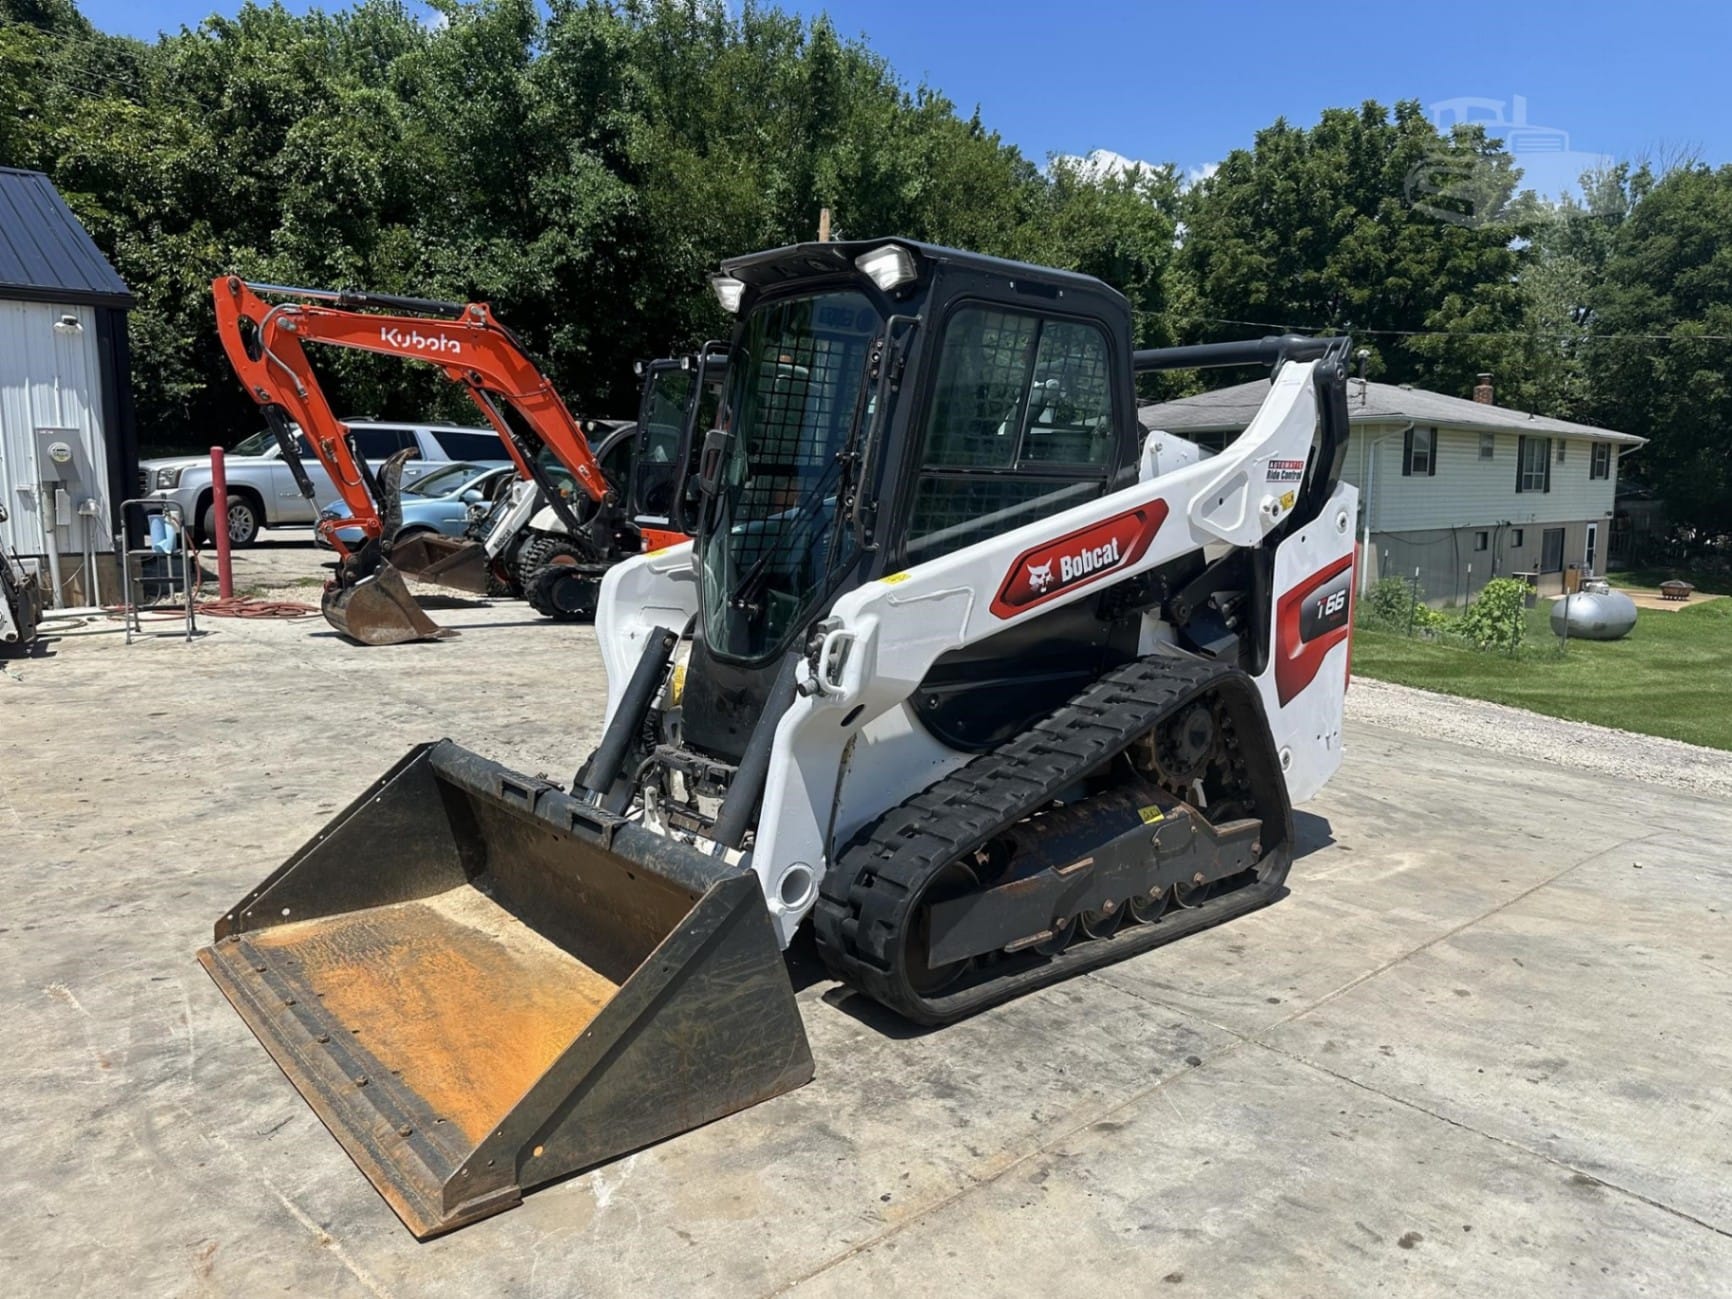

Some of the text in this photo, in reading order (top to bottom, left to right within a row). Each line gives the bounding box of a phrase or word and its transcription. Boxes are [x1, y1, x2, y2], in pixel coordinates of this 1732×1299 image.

[381, 327, 461, 354] Kubota
[1267, 470, 1302, 480] Ride Control
[1060, 537, 1119, 582] Bobcat
[1317, 589, 1346, 619] T66
